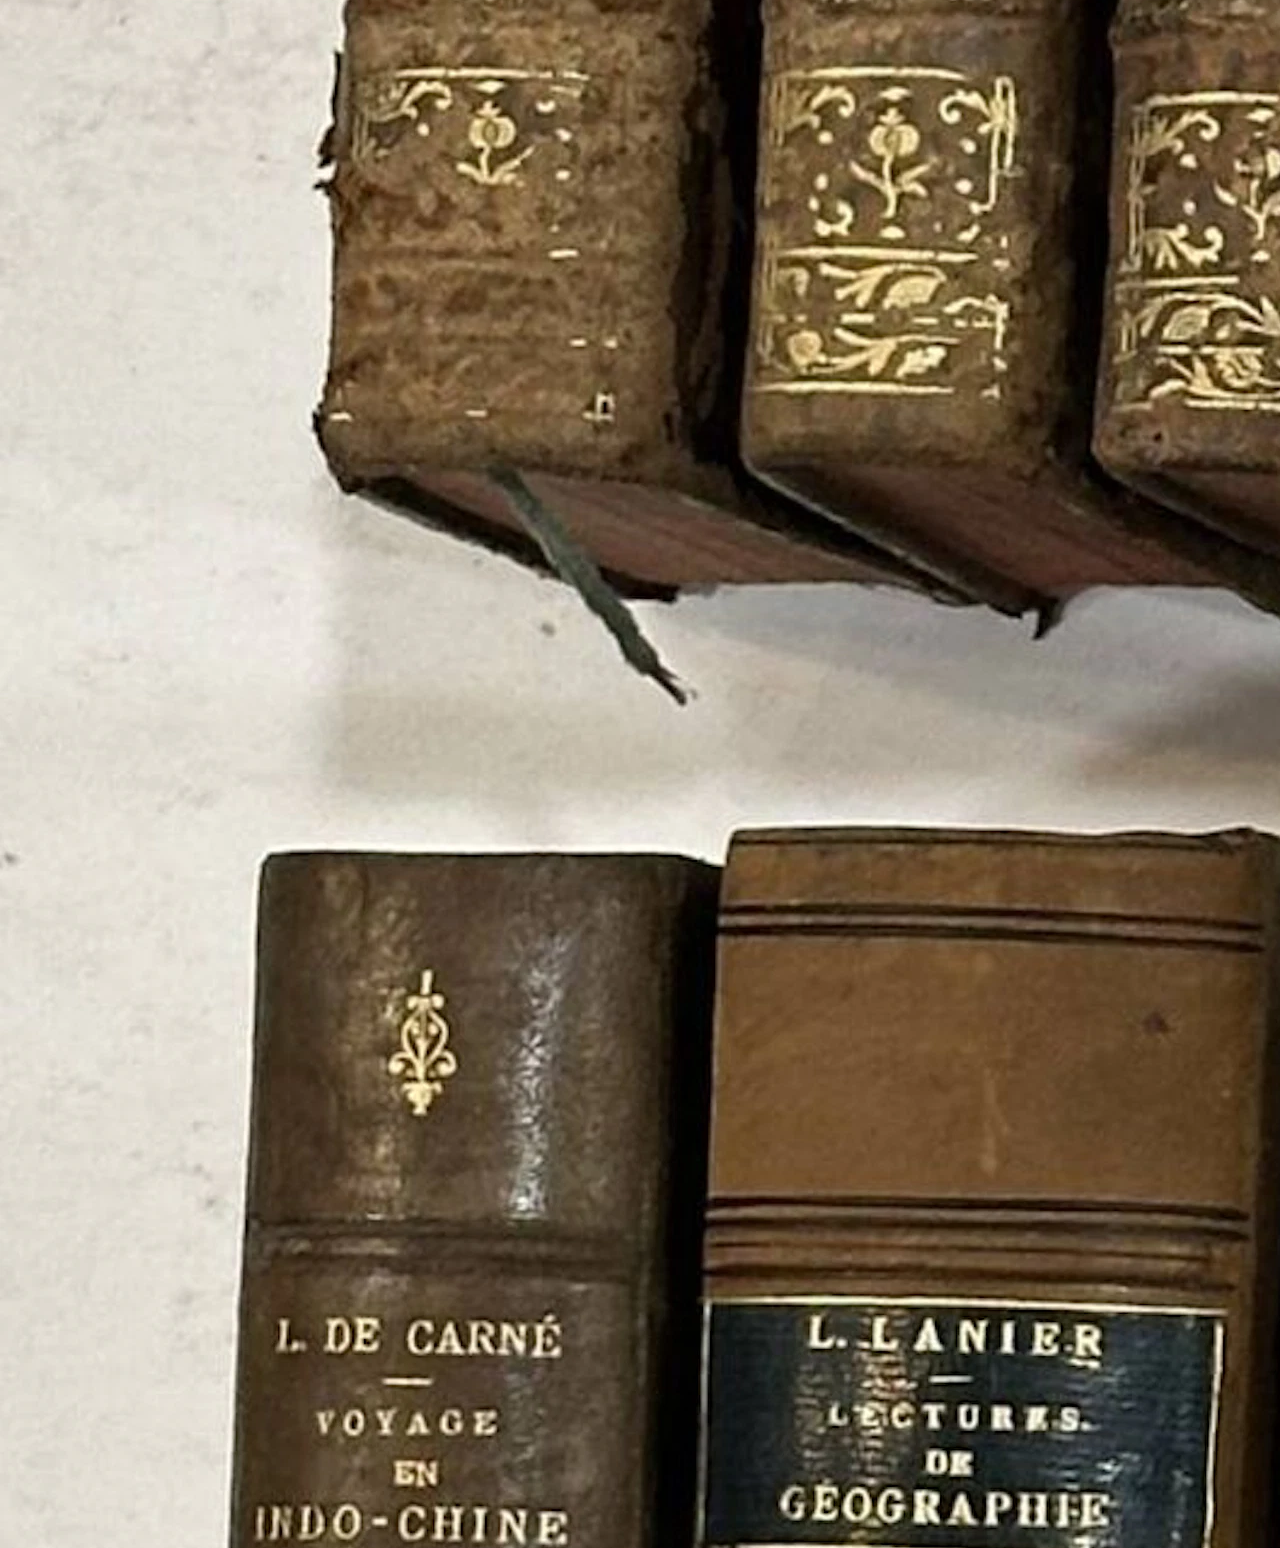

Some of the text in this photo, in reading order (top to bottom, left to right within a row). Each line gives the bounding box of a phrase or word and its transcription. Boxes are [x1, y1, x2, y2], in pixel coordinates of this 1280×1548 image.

[324, 1317, 381, 1354] DE
[407, 1312, 563, 1358] CARNÉ
[808, 1315, 1102, 1357] L. LANIER
[315, 1408, 498, 1437] VOYAGE
[393, 1460, 438, 1487] EN
[925, 1449, 973, 1477] DE
